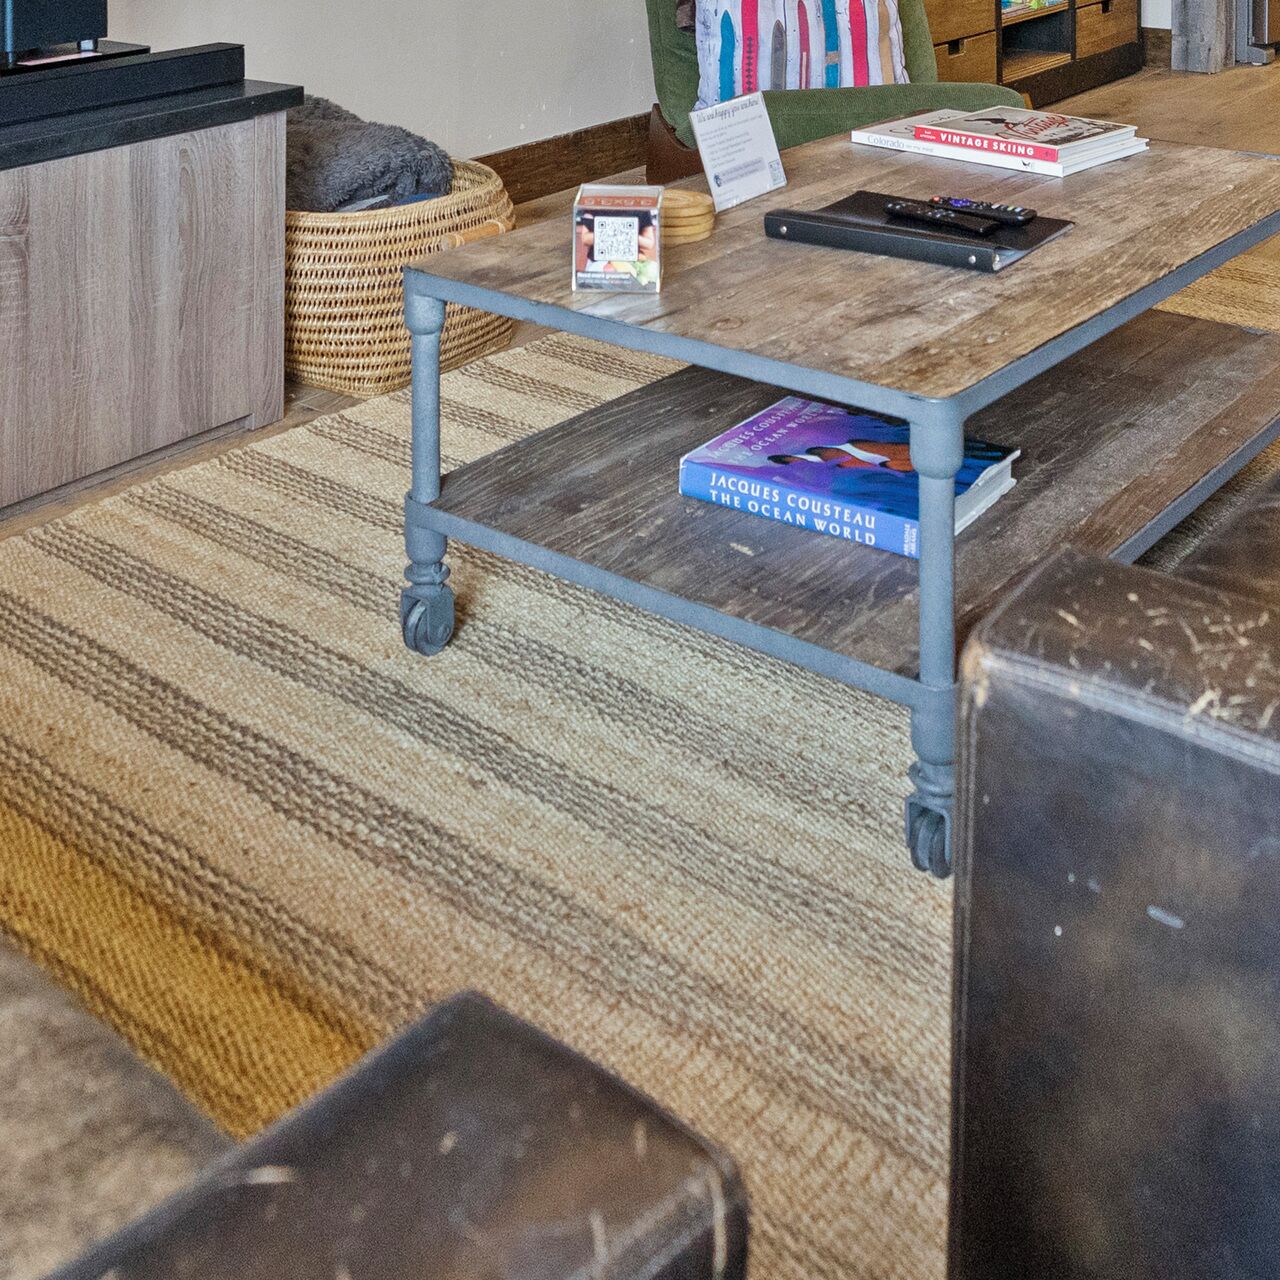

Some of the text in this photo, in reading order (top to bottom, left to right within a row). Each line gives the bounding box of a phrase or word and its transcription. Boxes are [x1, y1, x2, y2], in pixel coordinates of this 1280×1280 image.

[867, 134, 905, 150] Colorado
[940, 132, 988, 149] VINTAGE
[992, 141, 1035, 156] SKIING
[710, 429, 754, 459] JACQUES
[751, 427, 788, 452] OCEAN
[709, 472, 876, 530] JACQUES COUSTEAU
[709, 489, 876, 546] THE OCEAN WORLD
